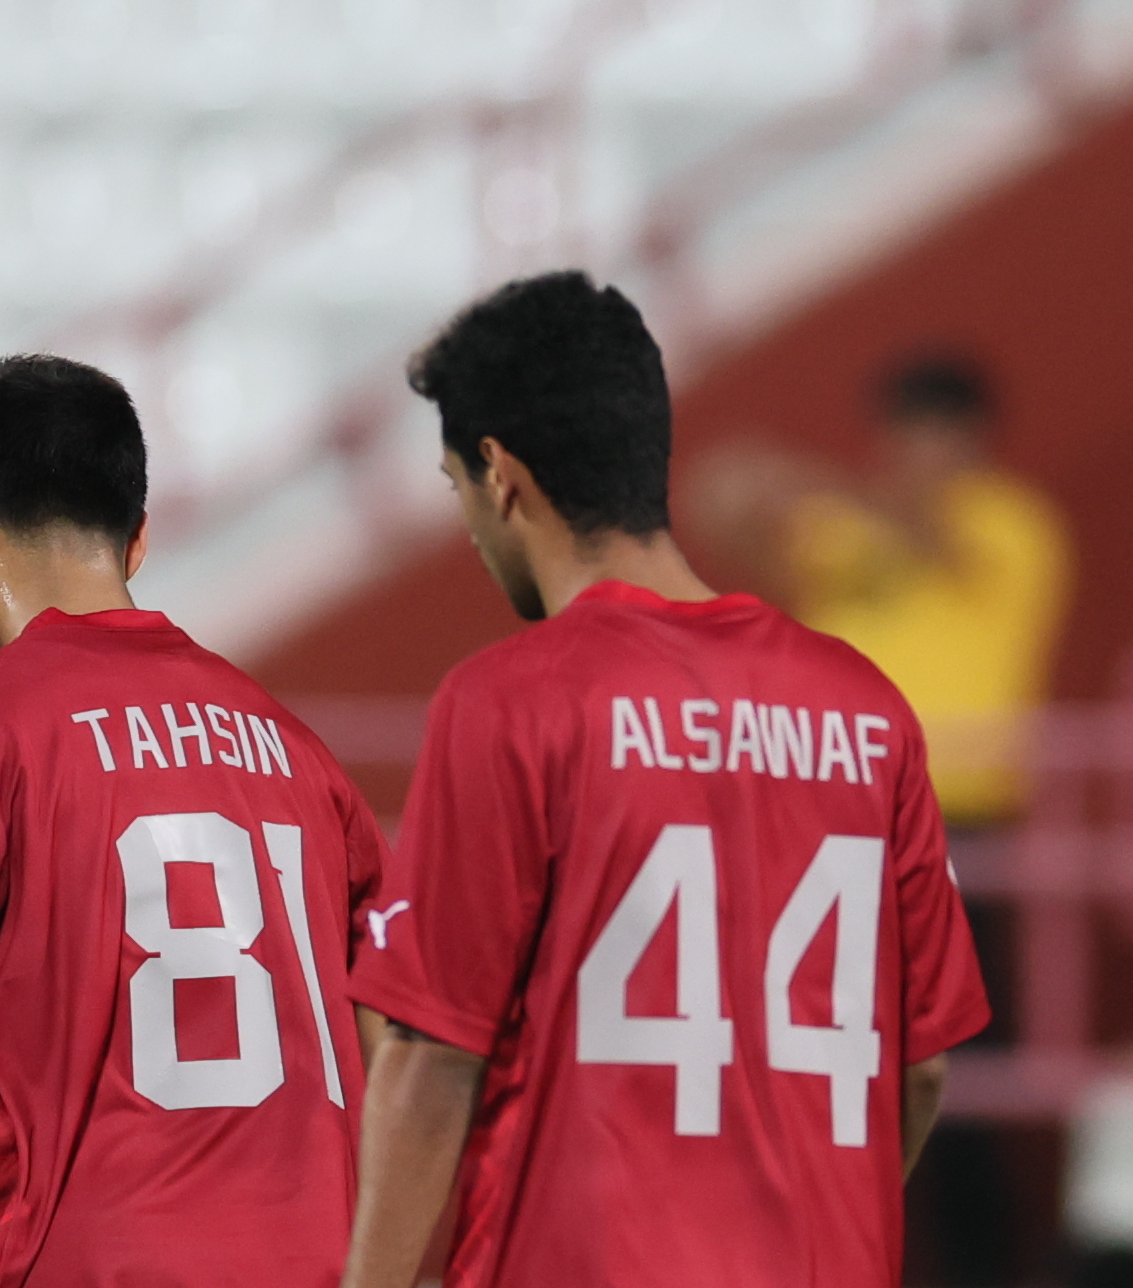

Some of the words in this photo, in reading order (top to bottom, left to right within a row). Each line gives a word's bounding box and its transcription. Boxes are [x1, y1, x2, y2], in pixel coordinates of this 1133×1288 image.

[71, 702, 293, 778] TAHSIN
[610, 696, 891, 785] ALSAWAF
[116, 811, 346, 1110] 81
[576, 823, 886, 1148] 44
